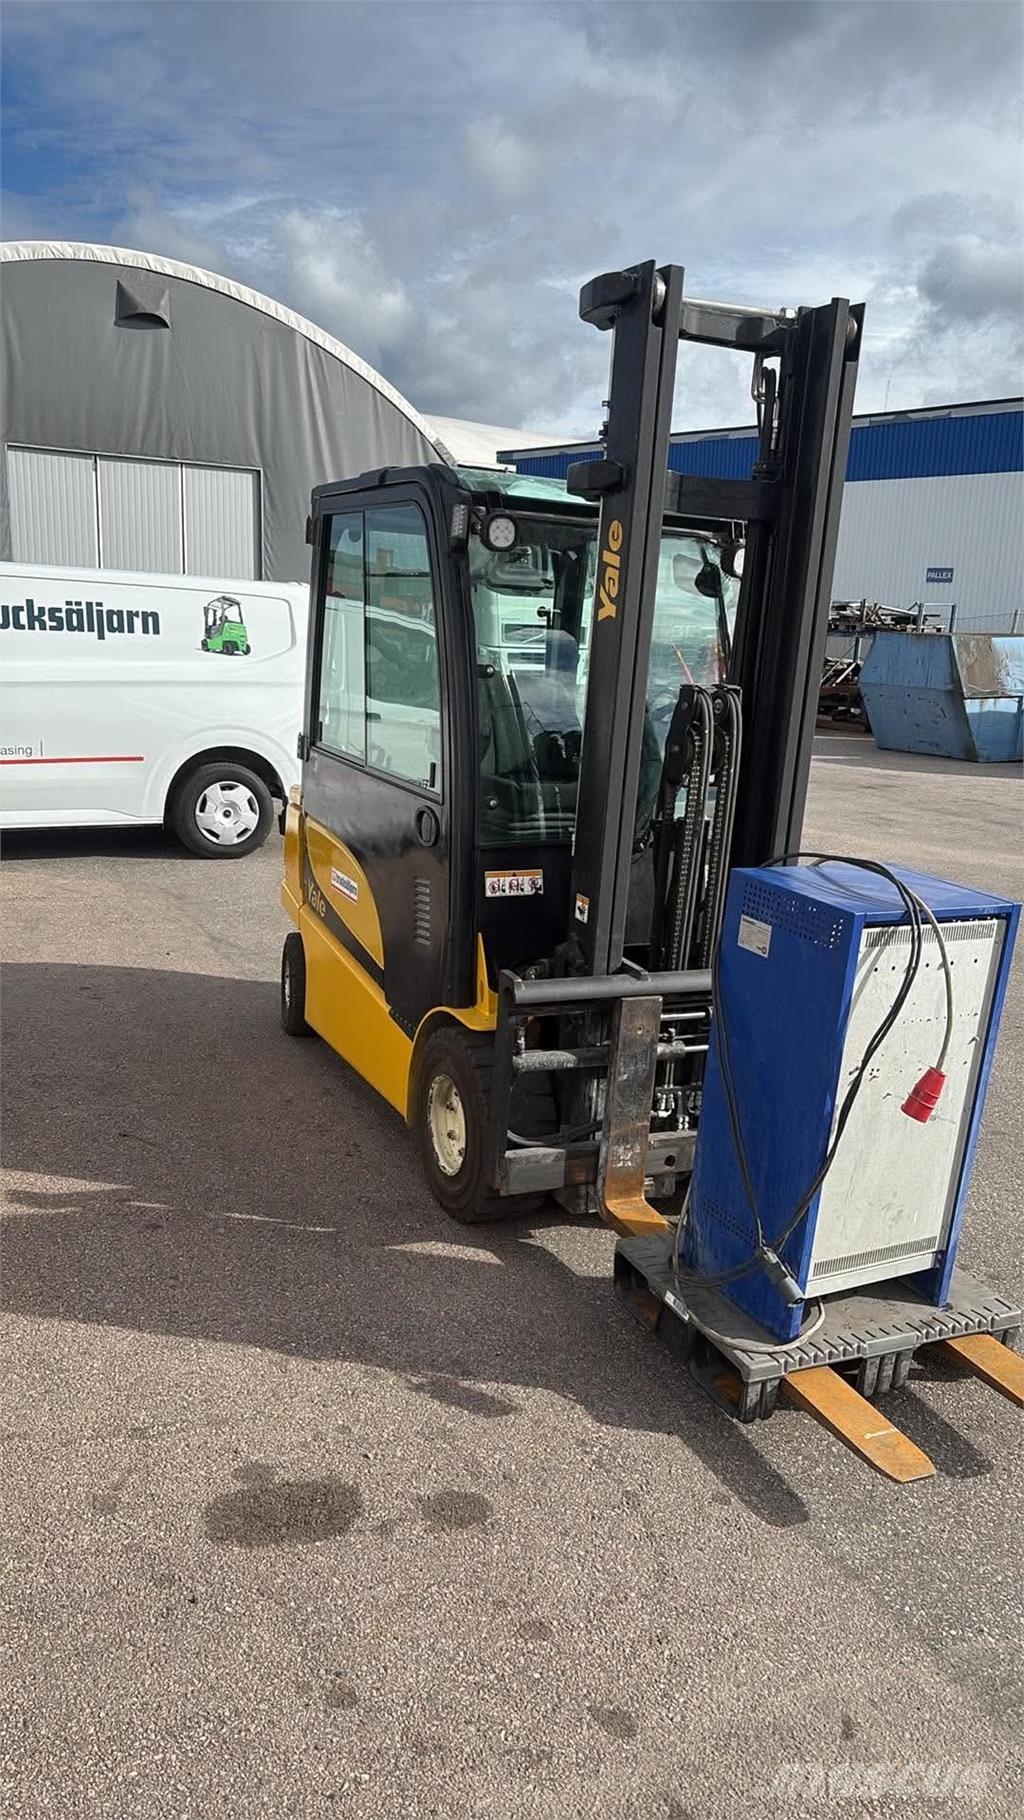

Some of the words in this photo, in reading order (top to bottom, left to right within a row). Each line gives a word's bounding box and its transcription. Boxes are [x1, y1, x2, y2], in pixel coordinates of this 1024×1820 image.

[598, 520, 623, 621] Yale
[0, 745, 33, 758] asing
[308, 881, 326, 917] Yale
